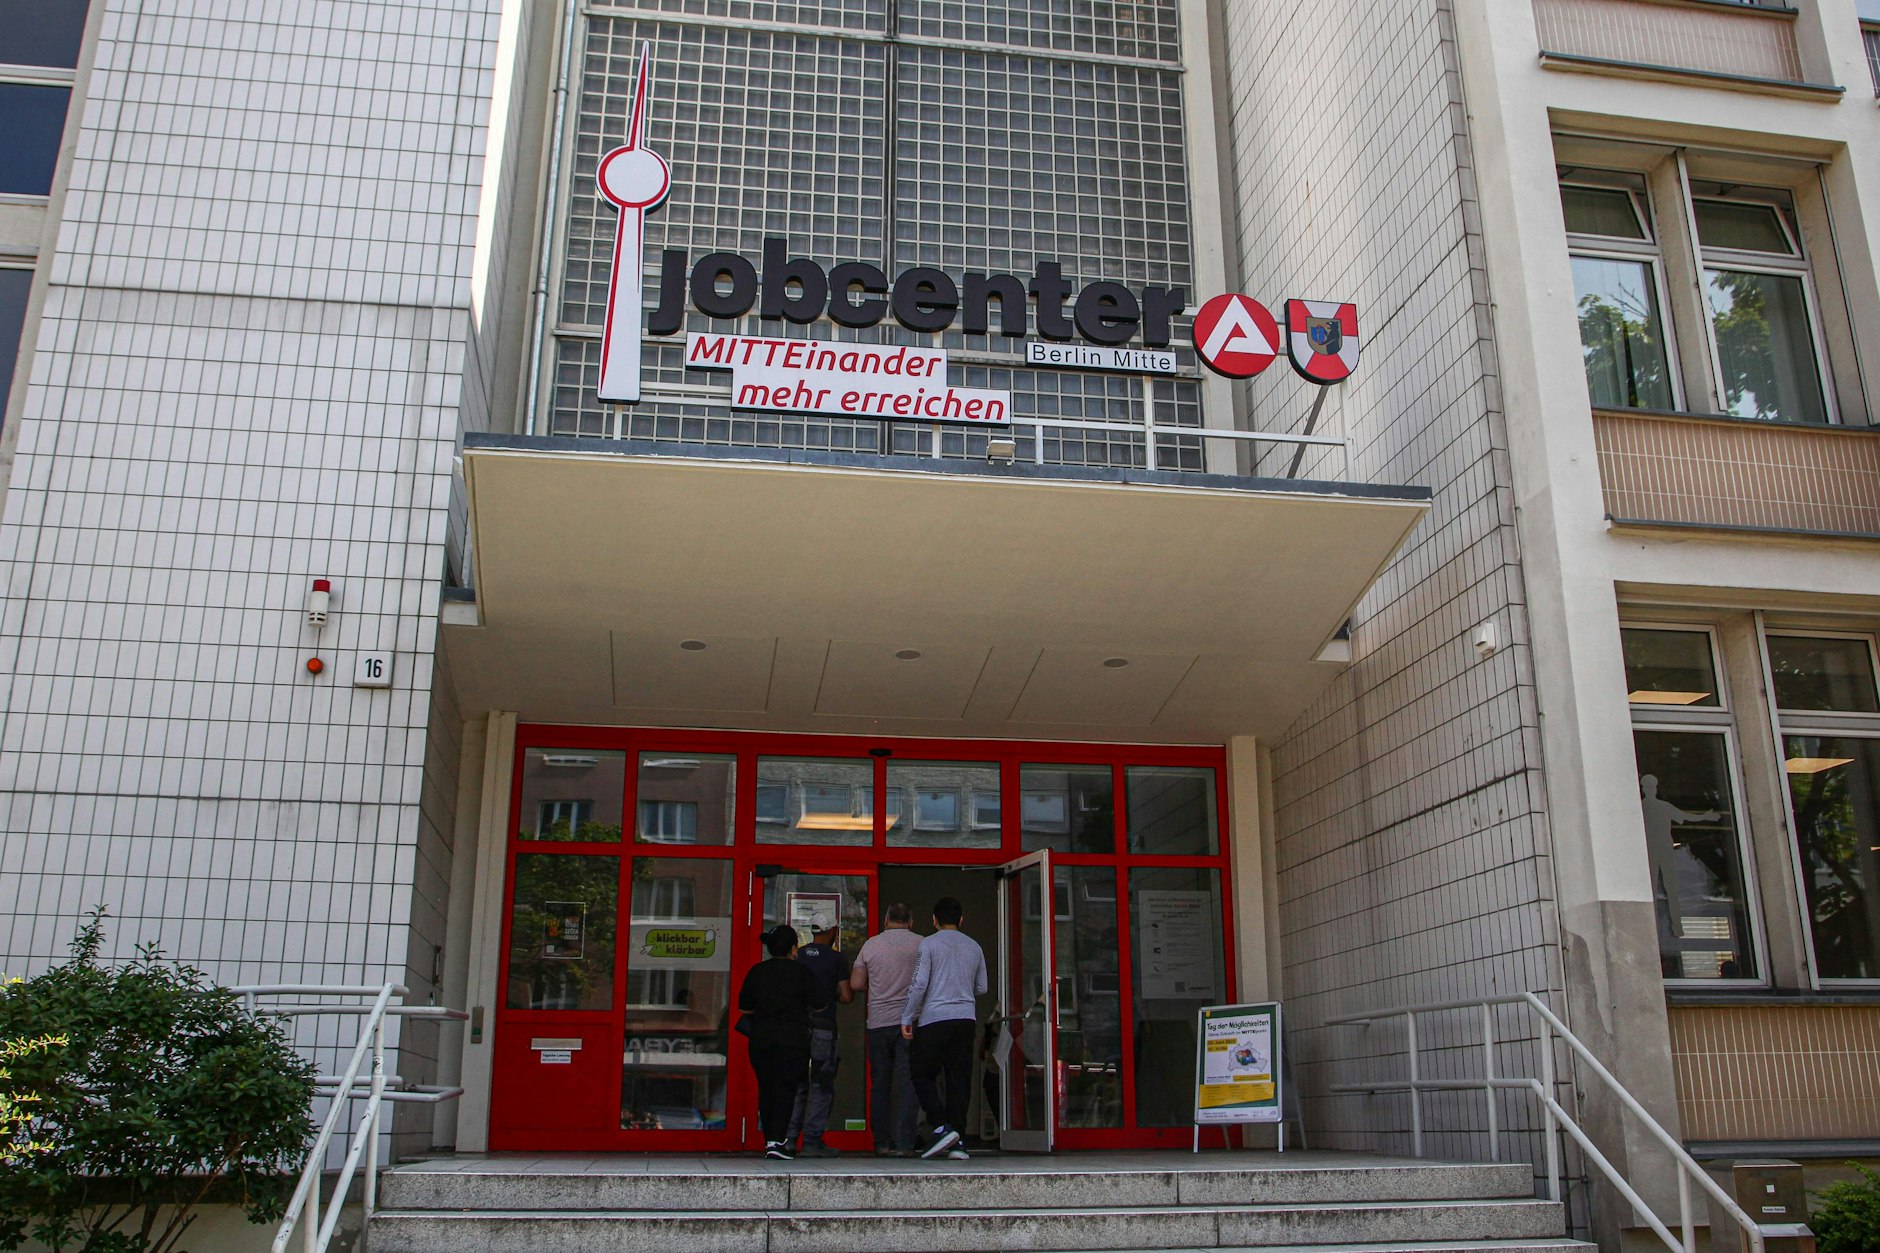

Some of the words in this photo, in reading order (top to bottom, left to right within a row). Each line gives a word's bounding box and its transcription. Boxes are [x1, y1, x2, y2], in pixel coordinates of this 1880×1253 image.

[690, 336, 942, 378] MITTEinander
[1032, 344, 1102, 366] Berlin
[1113, 351, 1171, 370] Mitte
[737, 380, 830, 410] mehr
[840, 388, 1005, 421] erreichen
[365, 658, 383, 678] 16
[656, 933, 701, 943] klickbar
[665, 944, 707, 955] klärbar
[1207, 1023, 1217, 1031] Tag
[1228, 1020, 1269, 1030] Möglichkeiten
